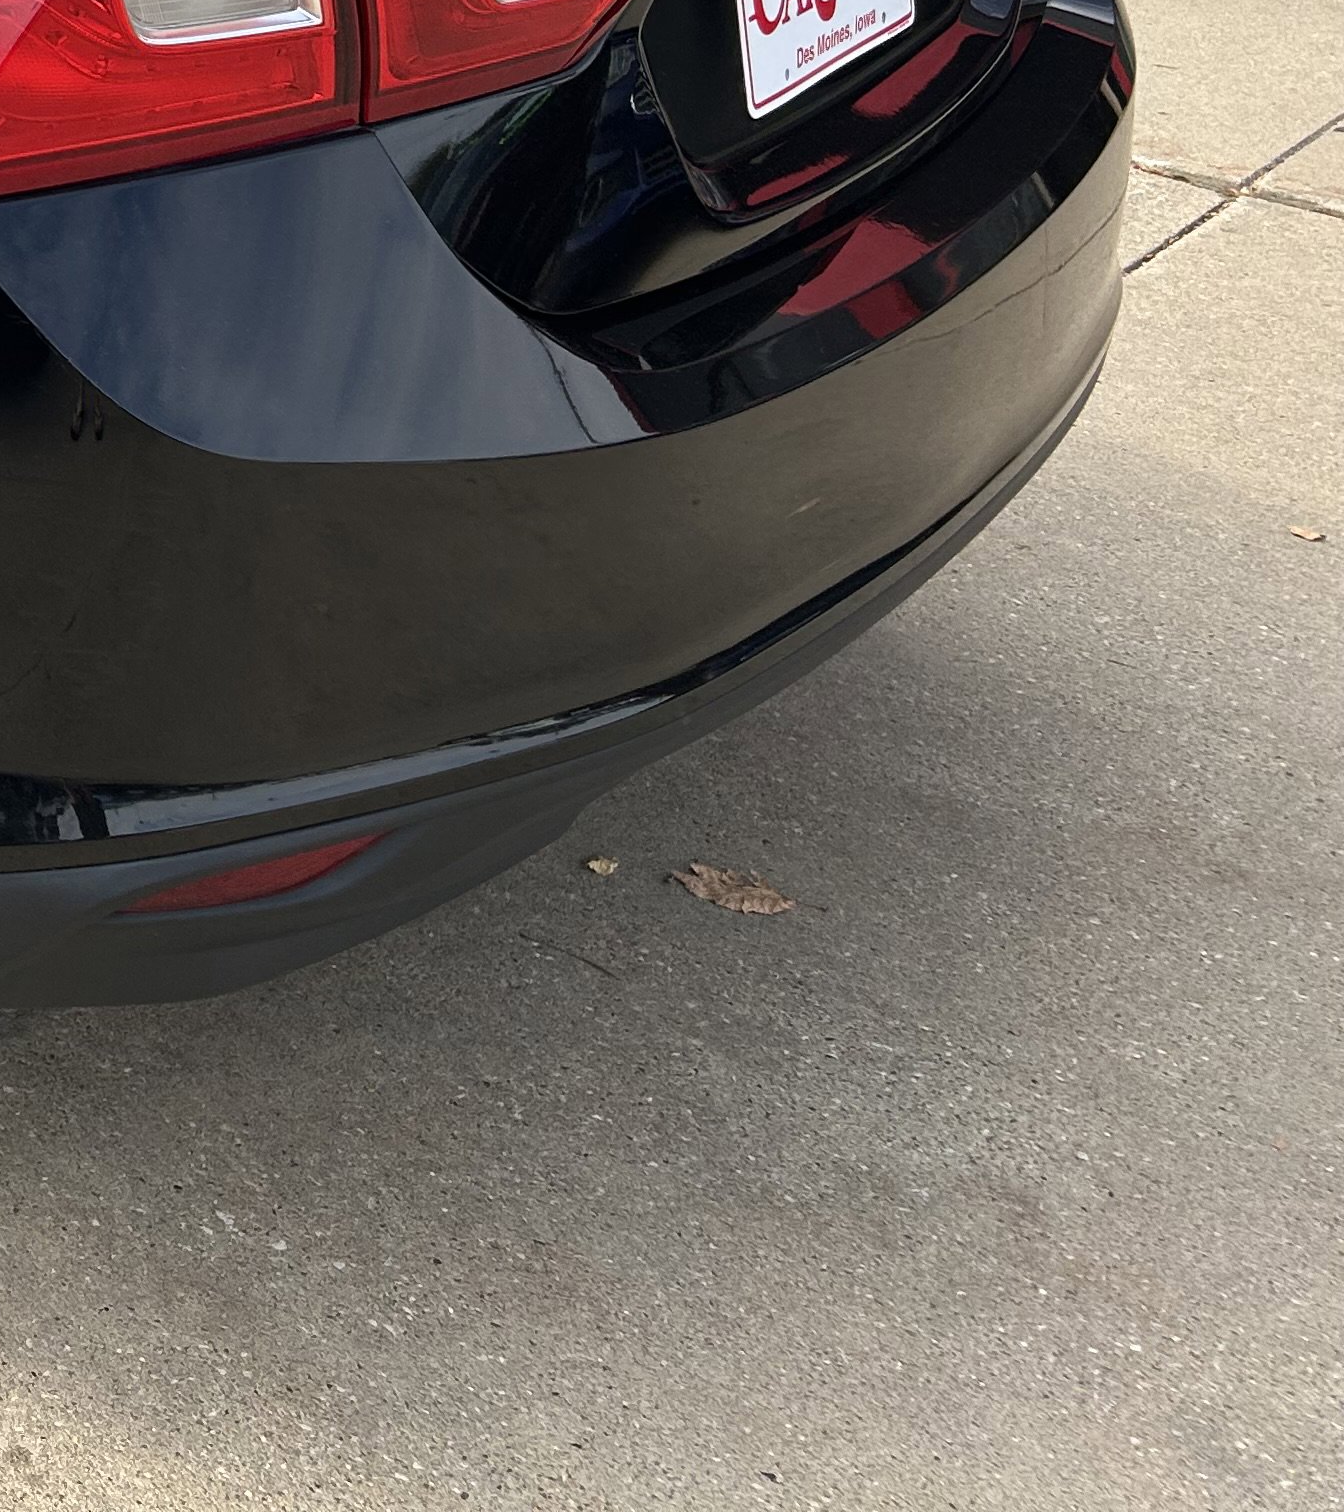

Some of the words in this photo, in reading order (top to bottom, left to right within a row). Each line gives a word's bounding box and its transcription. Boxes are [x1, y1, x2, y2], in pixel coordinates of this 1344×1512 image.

[796, 44, 816, 69] Des
[817, 22, 854, 56] Moines,
[855, 9, 877, 33] Iowa
